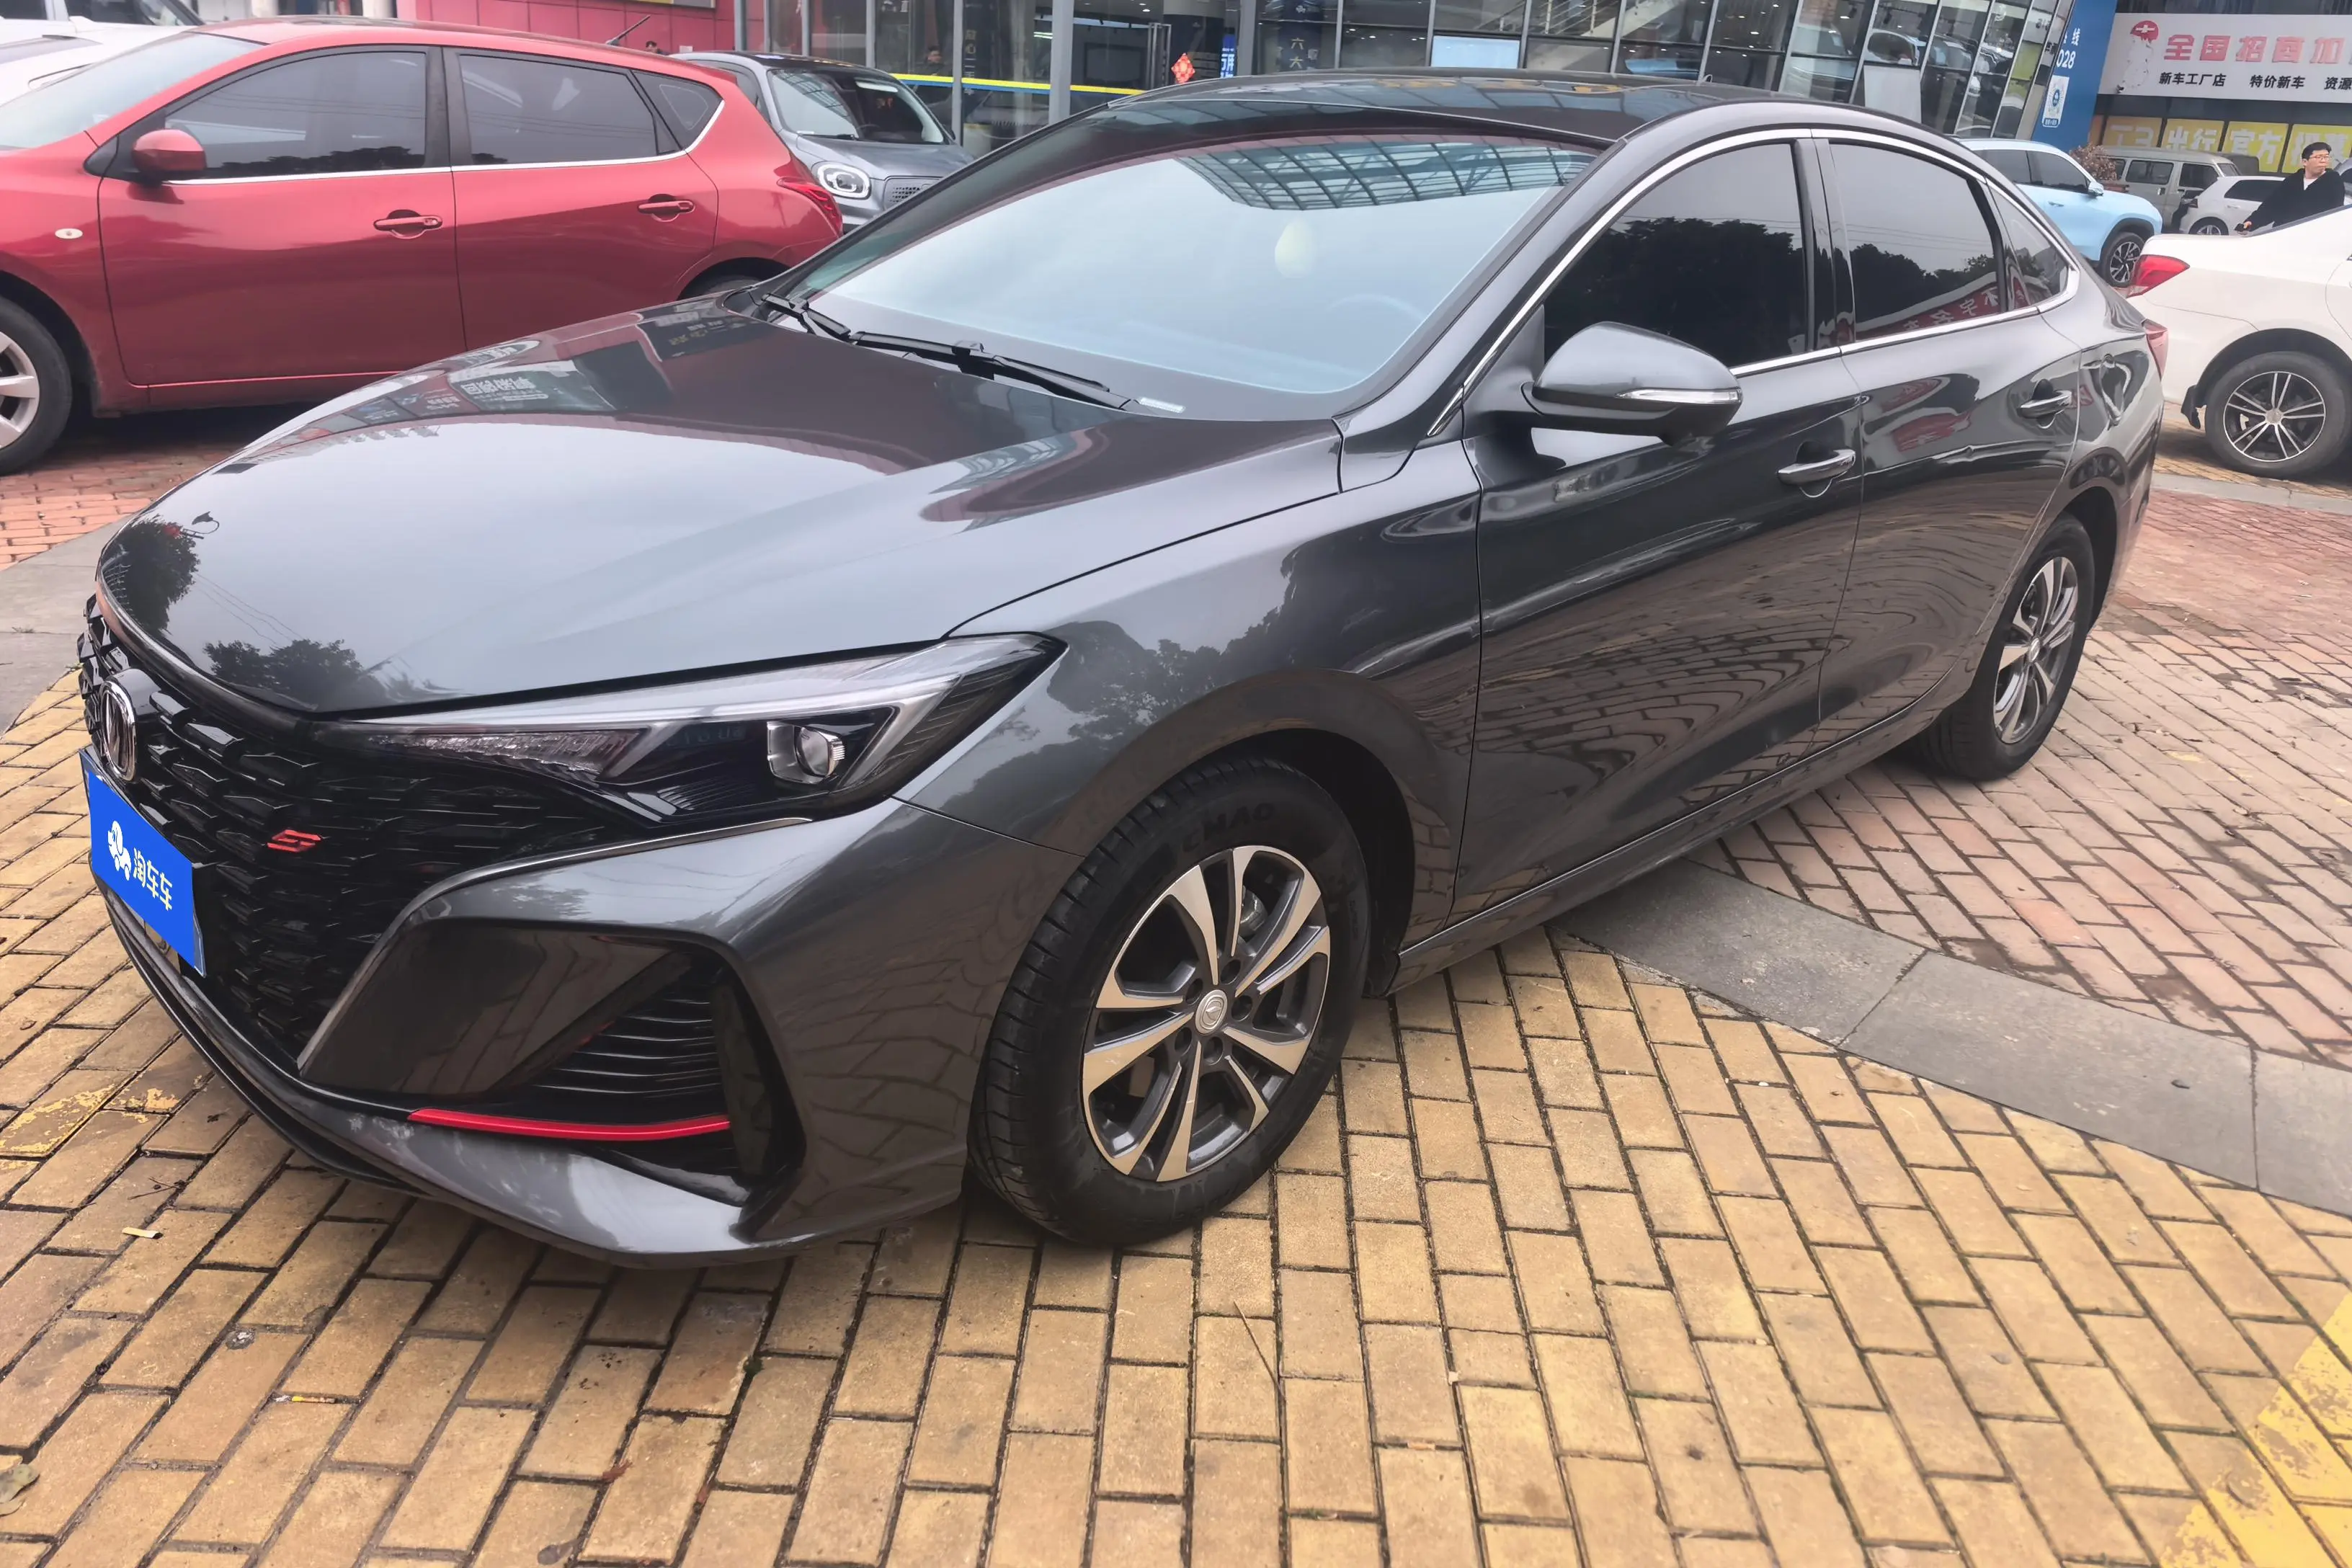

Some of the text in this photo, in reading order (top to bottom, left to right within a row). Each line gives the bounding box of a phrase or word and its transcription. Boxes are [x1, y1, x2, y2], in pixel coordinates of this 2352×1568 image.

[2164, 34, 2352, 65] 全国招商加
[2159, 71, 2352, 91] 新车工厂店 特价新车 资源
